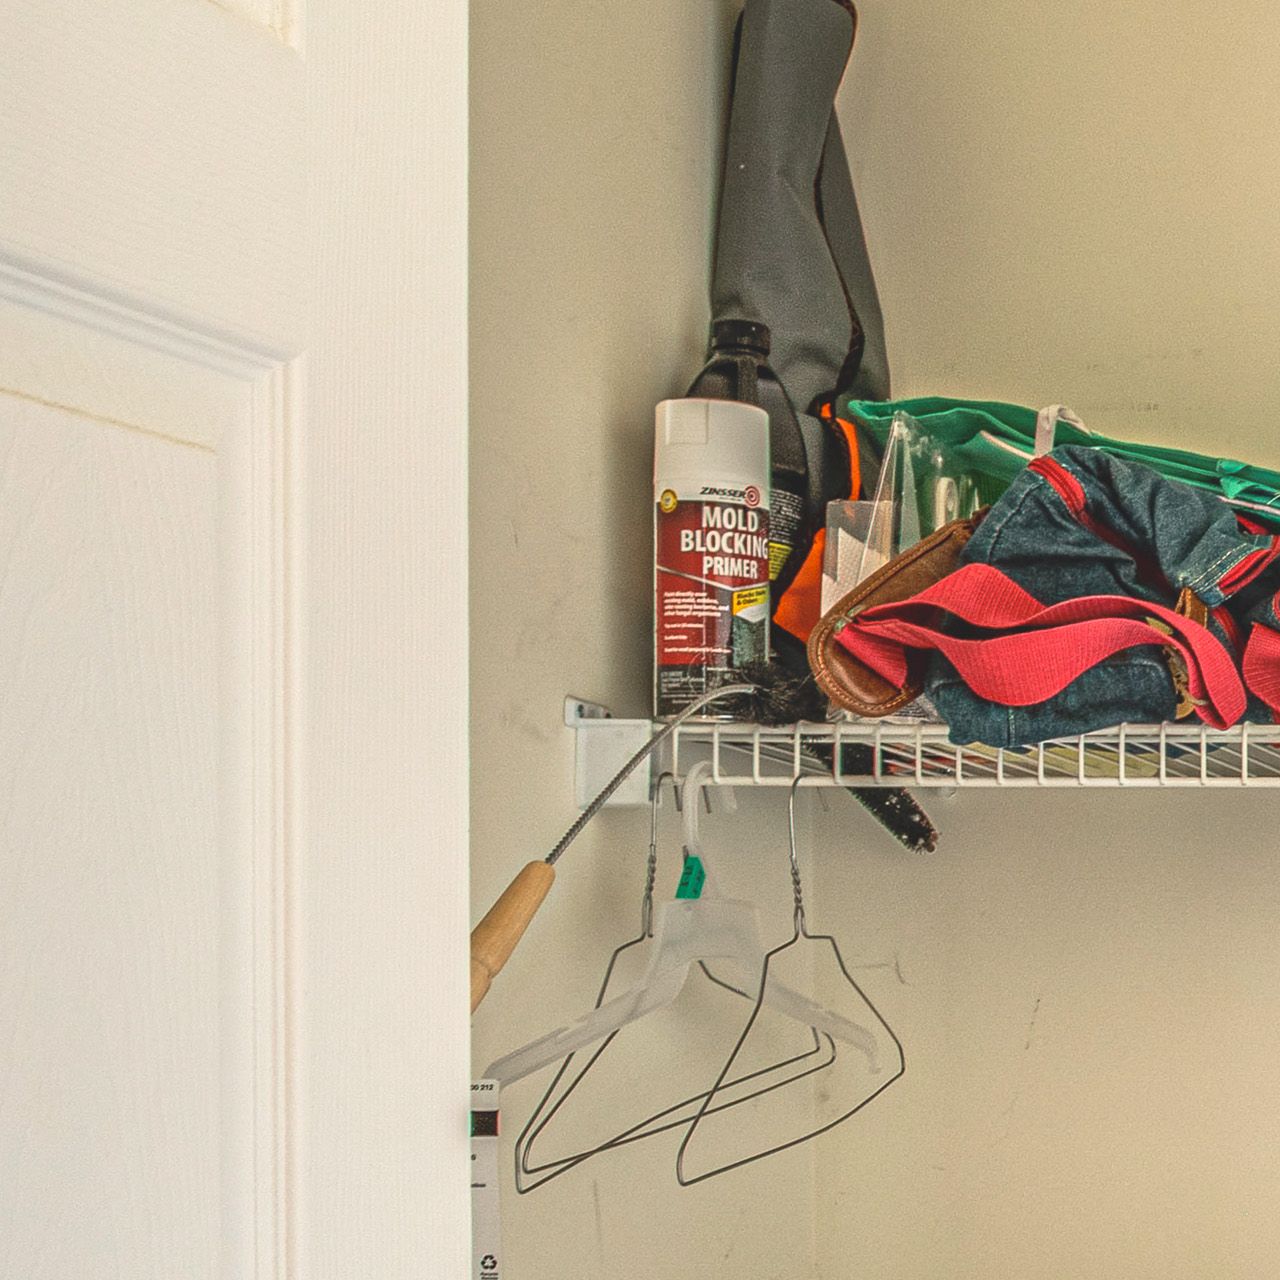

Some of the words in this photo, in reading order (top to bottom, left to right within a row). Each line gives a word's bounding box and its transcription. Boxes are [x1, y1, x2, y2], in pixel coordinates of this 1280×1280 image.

[700, 486, 746, 498] ZINSSER
[702, 505, 759, 532] MOLD
[680, 529, 769, 559] BLOCKING
[702, 555, 758, 579] PRIMER
